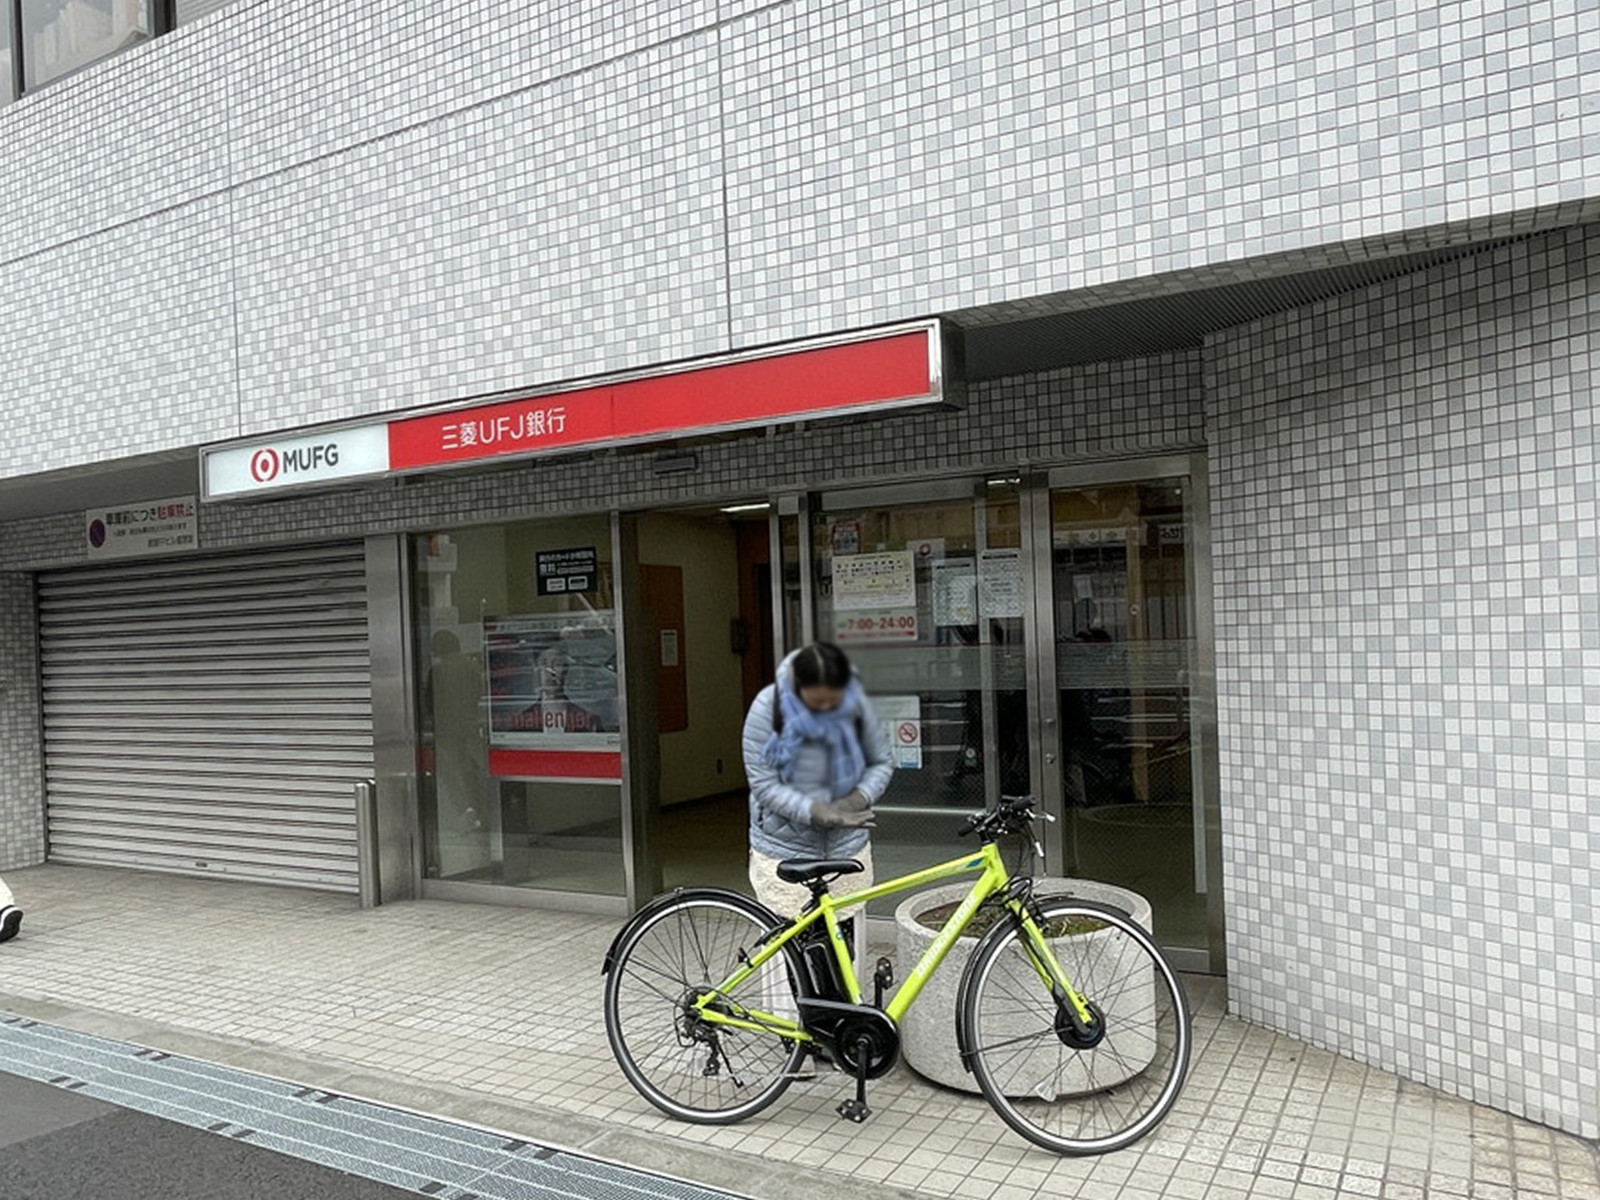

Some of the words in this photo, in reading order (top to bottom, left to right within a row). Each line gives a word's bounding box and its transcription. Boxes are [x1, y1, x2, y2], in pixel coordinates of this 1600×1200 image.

[442, 407, 566, 450] 三菱UFJ銀行
[283, 443, 339, 473] MUFG
[106, 504, 194, 525] 前につき駐禁止
